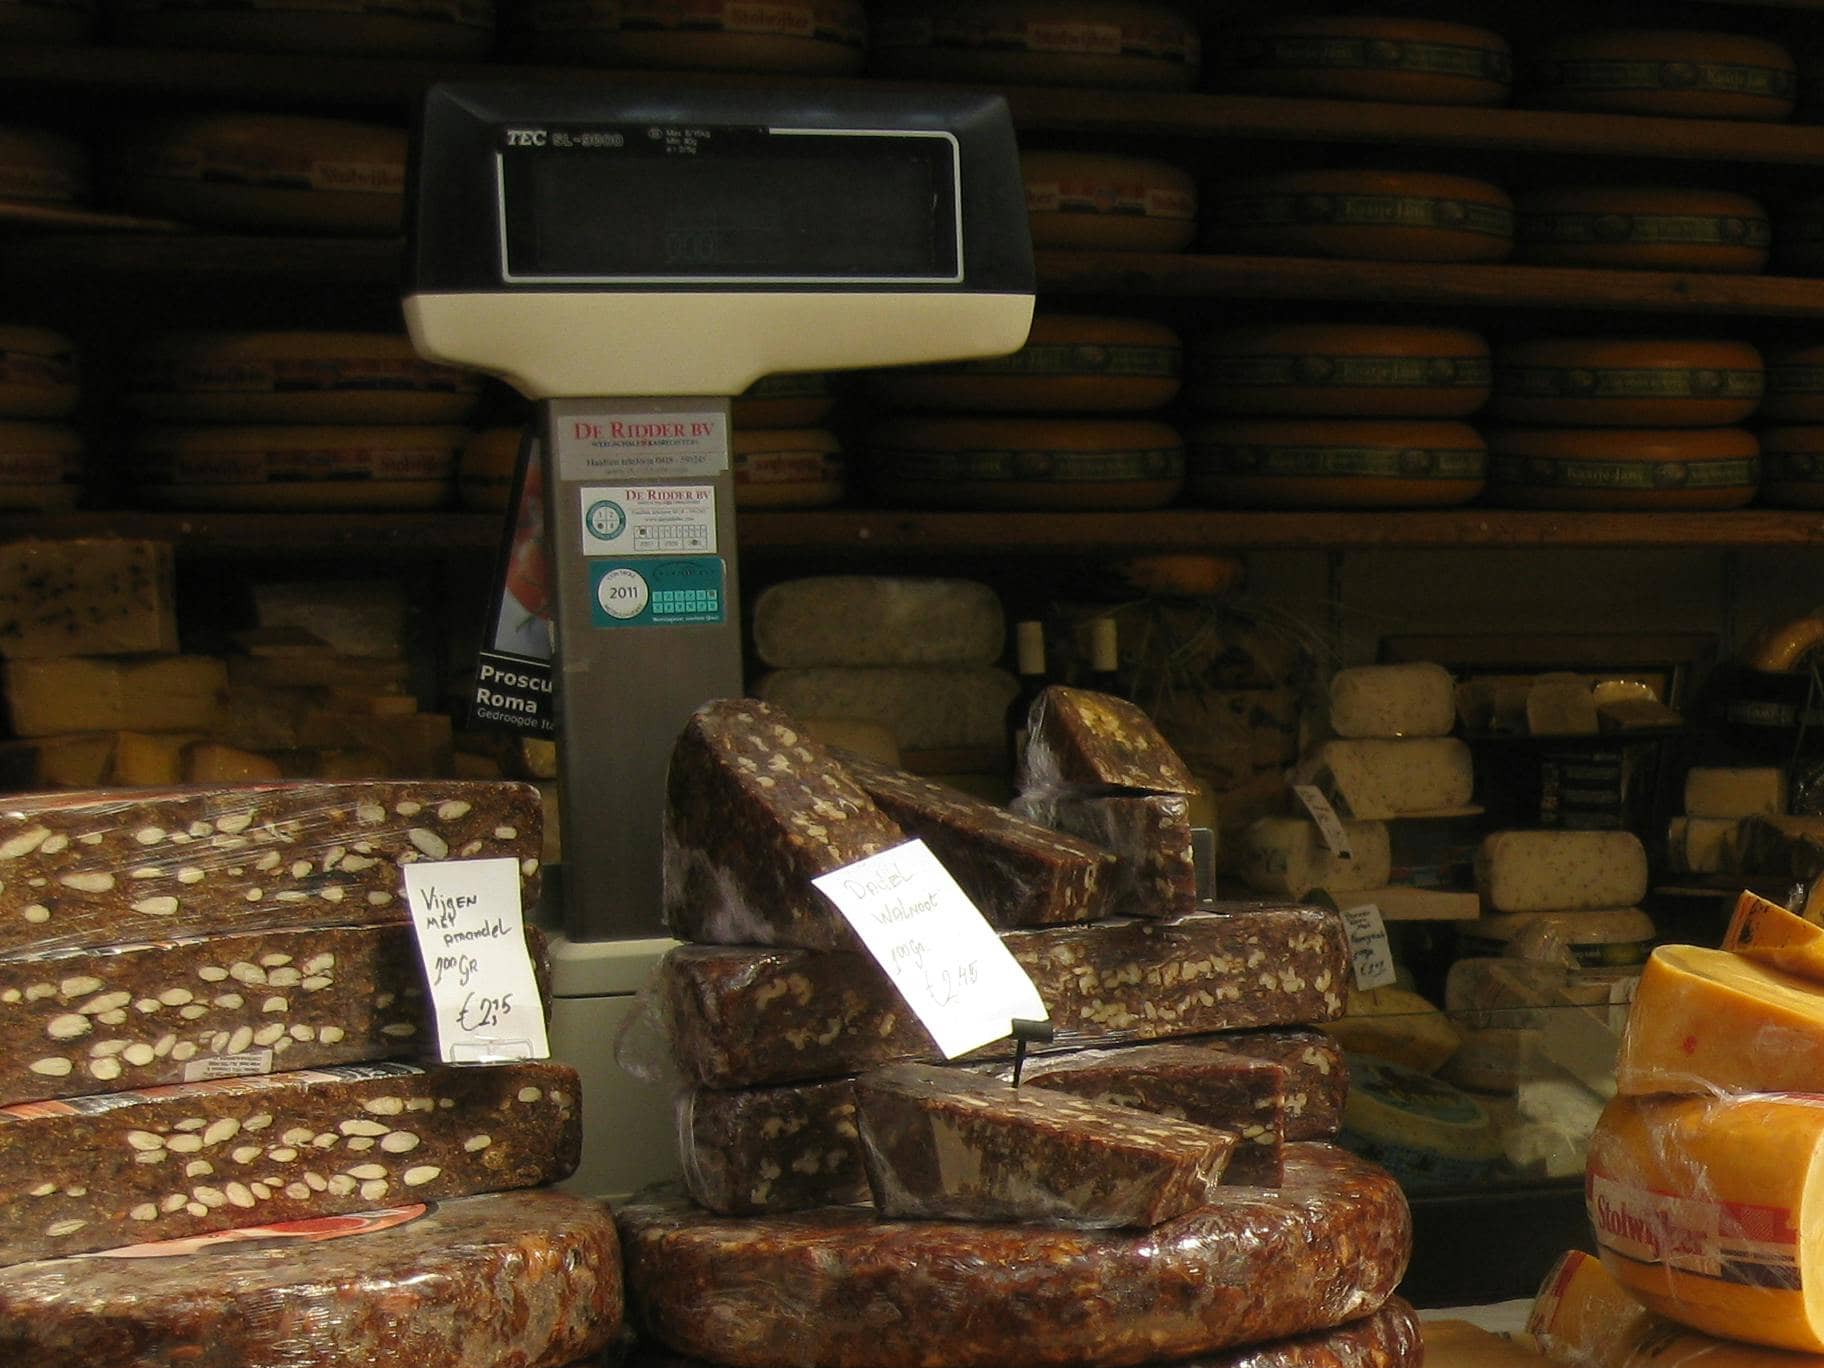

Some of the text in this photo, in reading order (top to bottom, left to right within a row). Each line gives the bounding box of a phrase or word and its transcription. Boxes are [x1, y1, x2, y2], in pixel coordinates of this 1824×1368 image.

[507, 129, 547, 146] TEC
[609, 587, 638, 599] 2011
[476, 687, 538, 714] Roma
[477, 707, 538, 727] Gedroogde
